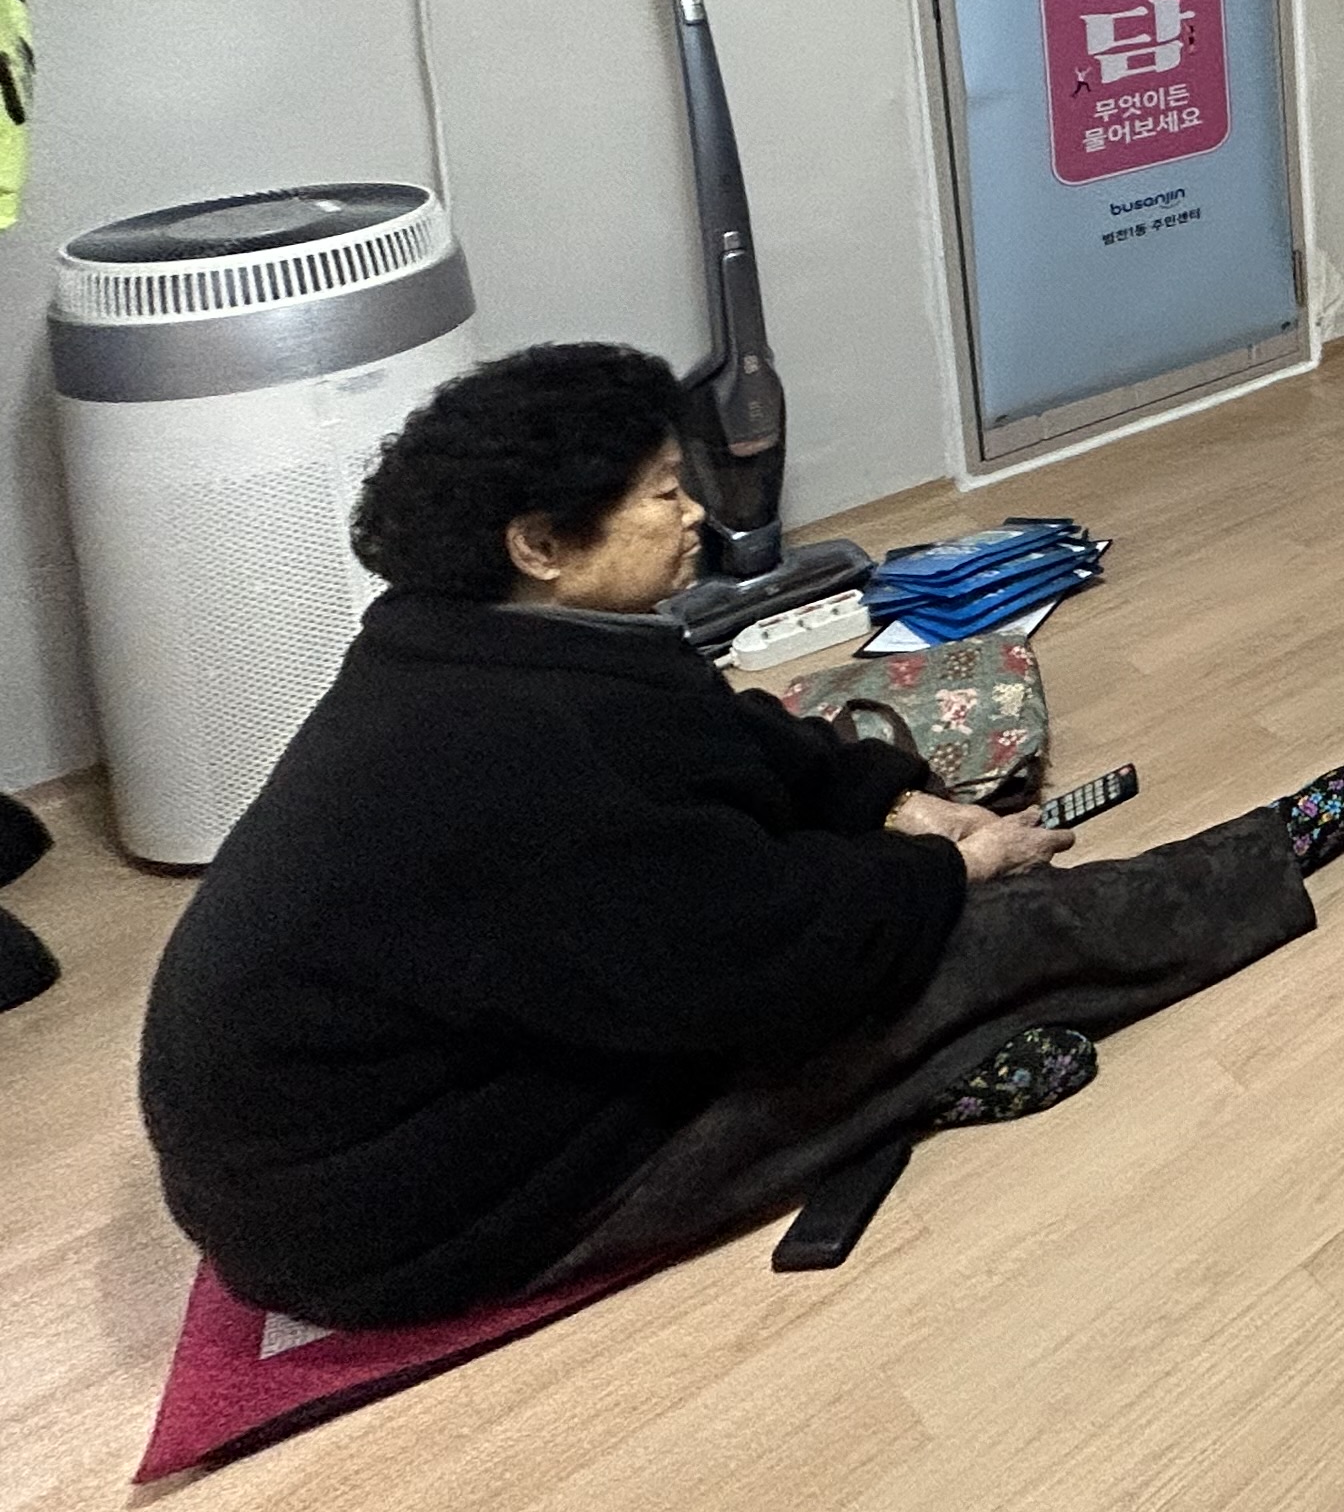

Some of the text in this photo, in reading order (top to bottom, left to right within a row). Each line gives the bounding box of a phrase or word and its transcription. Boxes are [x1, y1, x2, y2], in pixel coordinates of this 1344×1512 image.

[1094, 83, 1190, 123] 무엇이든
[1082, 106, 1204, 154] 물어보세요
[1109, 188, 1186, 217] busanjin
